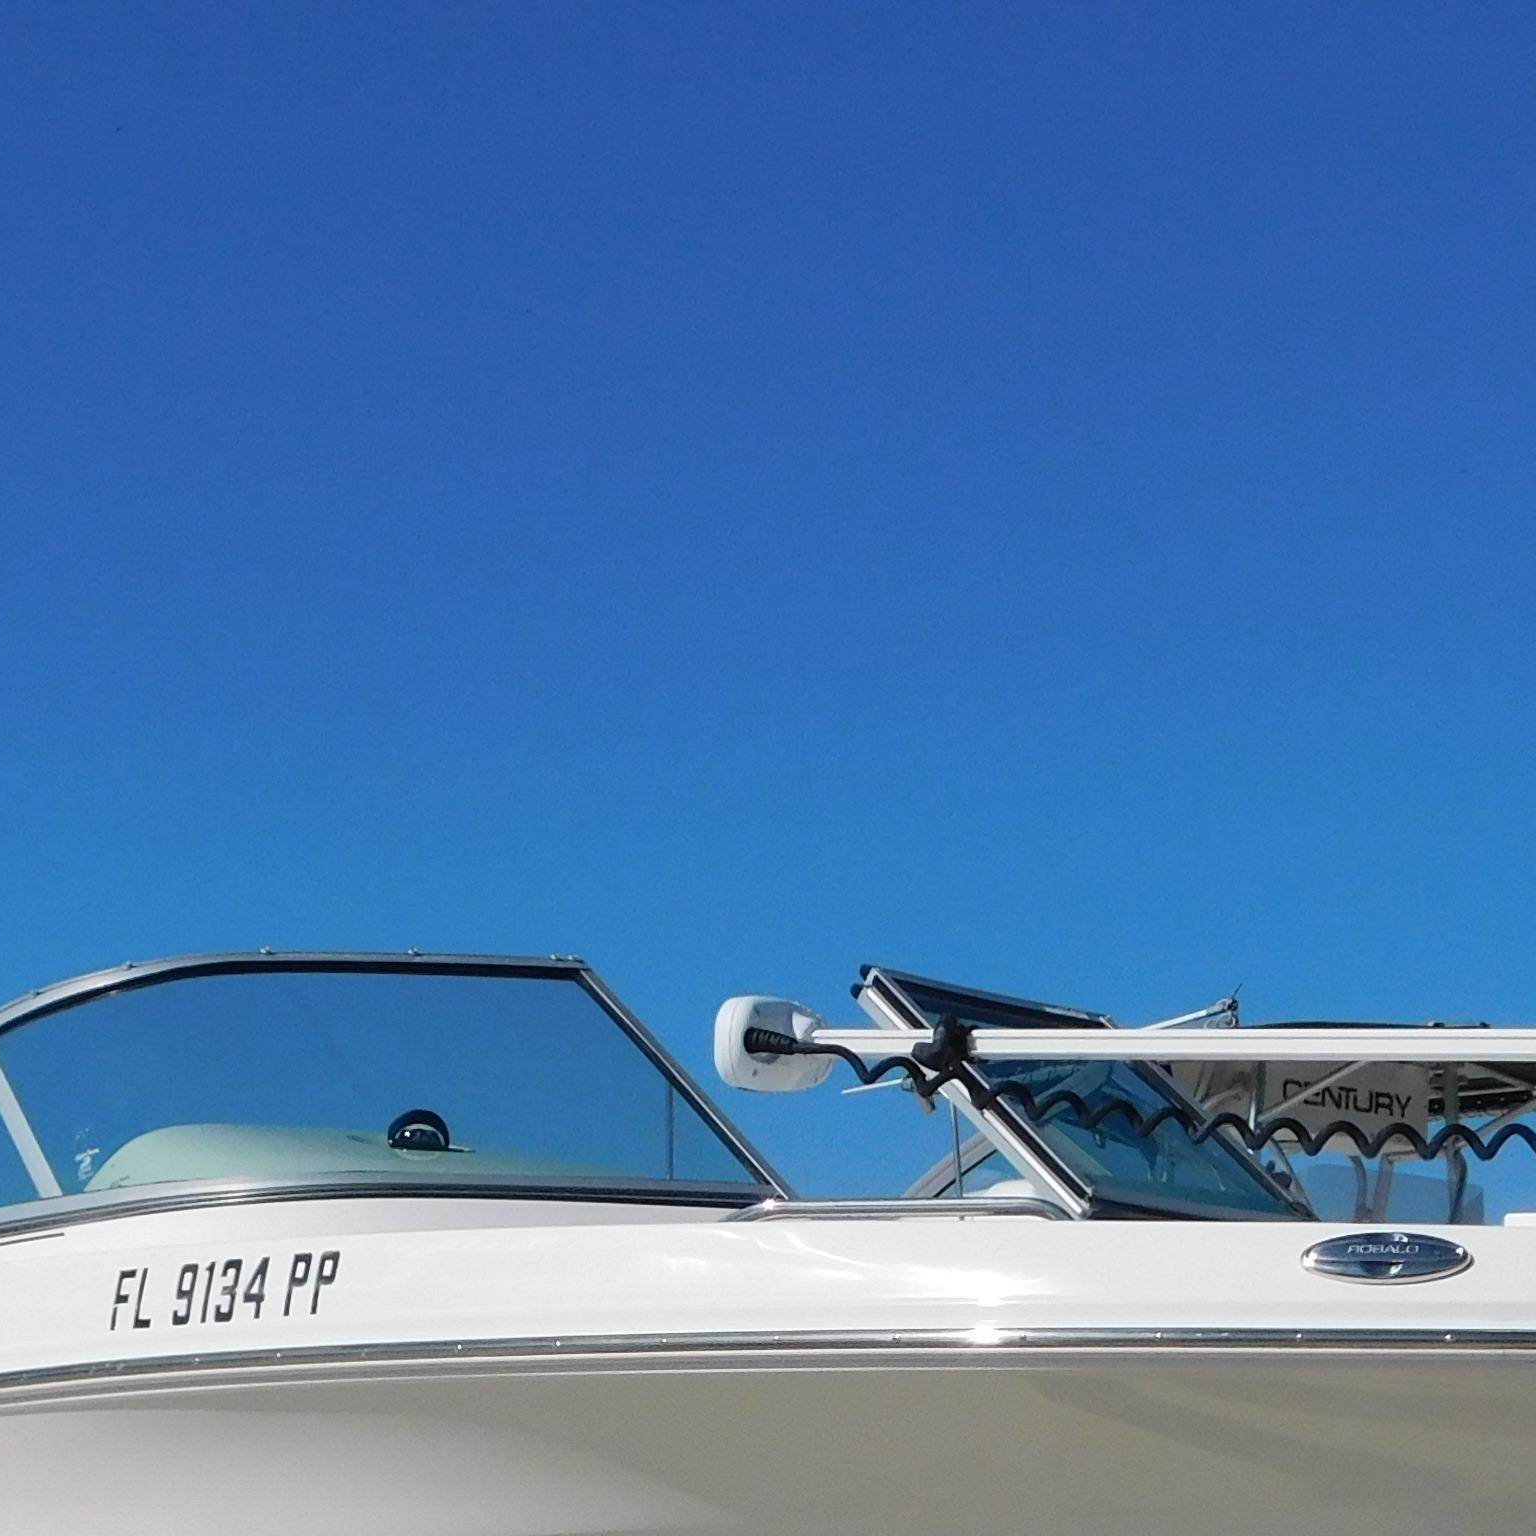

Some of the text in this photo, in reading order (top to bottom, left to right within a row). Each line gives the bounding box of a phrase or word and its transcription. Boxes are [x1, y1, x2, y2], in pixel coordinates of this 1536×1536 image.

[1347, 1244, 1419, 1254] ROBALO
[110, 1250, 340, 1331] FL 9134 PP
